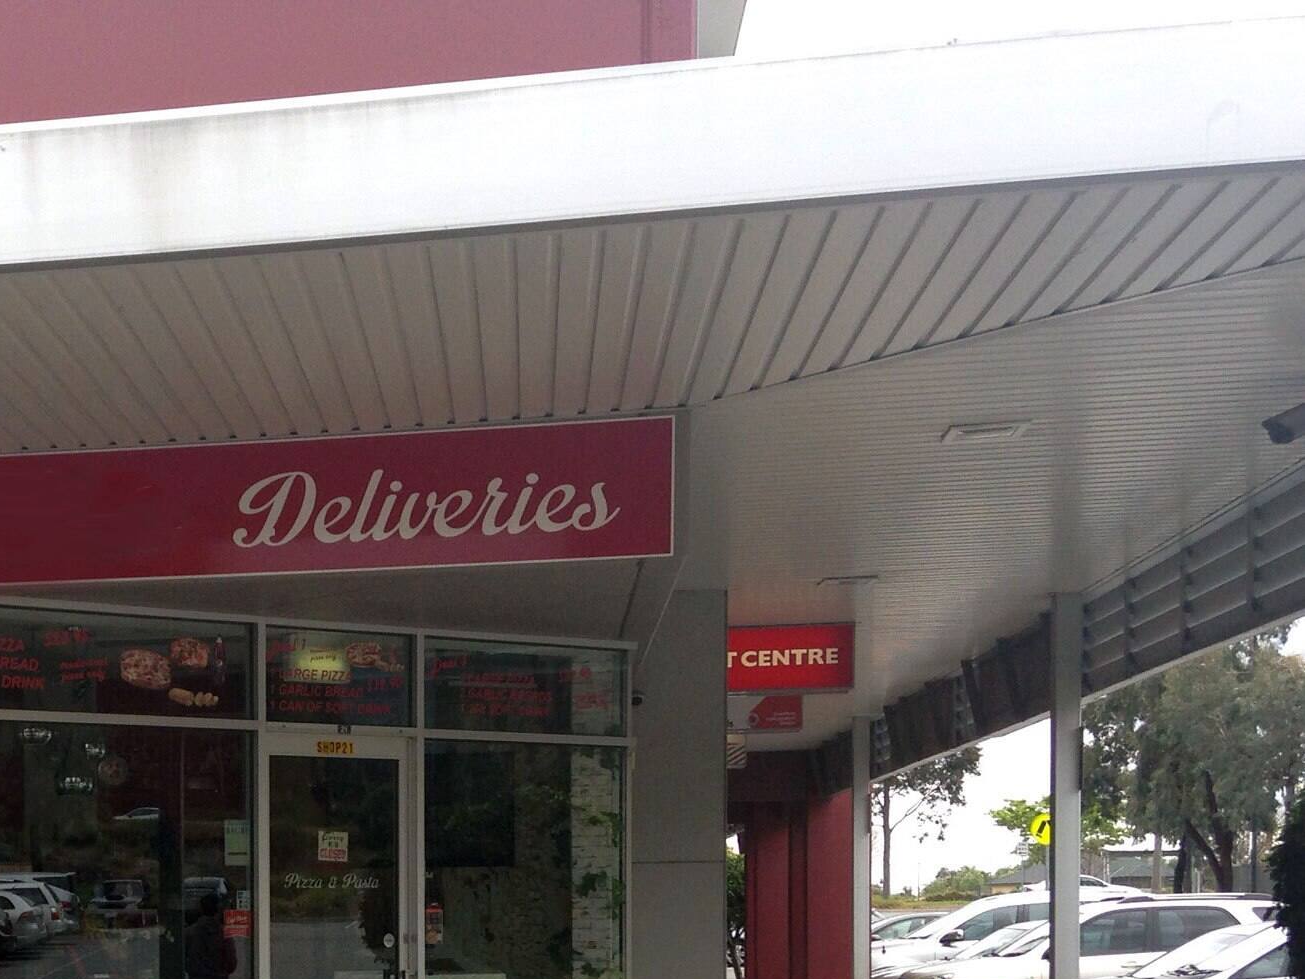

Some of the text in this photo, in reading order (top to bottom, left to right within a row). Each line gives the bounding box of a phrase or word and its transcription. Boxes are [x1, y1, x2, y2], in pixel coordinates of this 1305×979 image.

[232, 468, 621, 549] Deliveries
[740, 647, 839, 668] CENTRE
[1, 675, 46, 690] DRINK
[283, 872, 322, 890] Pizza
[341, 872, 381, 890] Pasta
